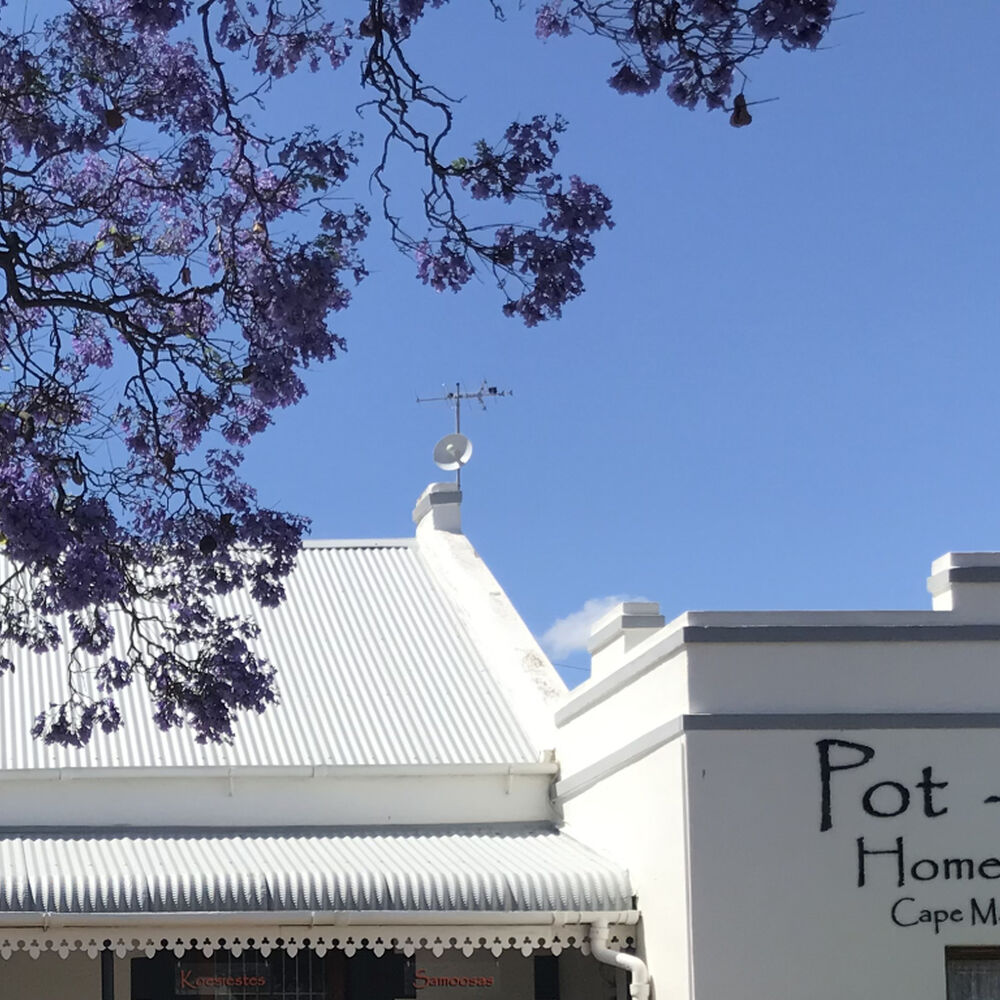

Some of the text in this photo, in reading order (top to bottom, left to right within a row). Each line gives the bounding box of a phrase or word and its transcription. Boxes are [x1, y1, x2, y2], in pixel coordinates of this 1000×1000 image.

[815, 739, 949, 832] Pot
[891, 897, 1000, 934] Cape M
[412, 968, 494, 989] Samoosas
